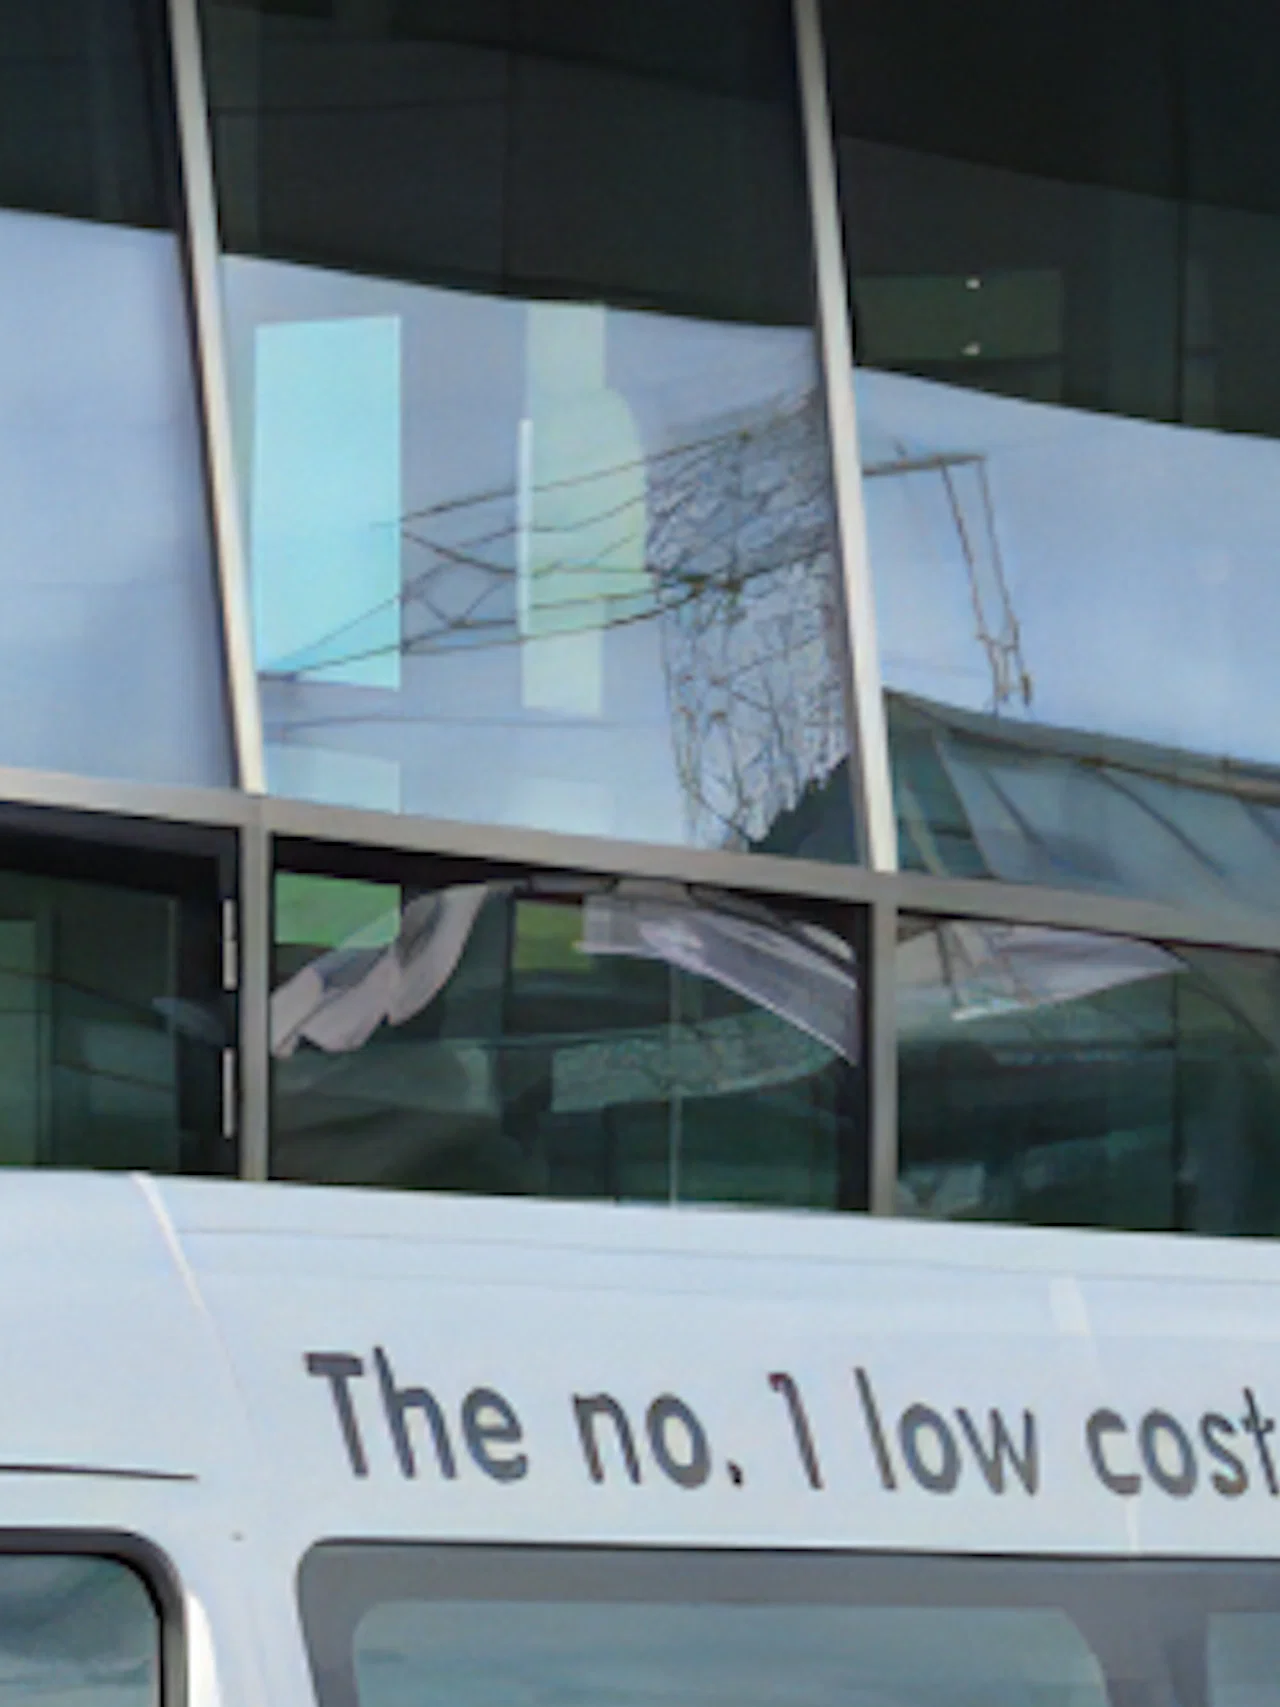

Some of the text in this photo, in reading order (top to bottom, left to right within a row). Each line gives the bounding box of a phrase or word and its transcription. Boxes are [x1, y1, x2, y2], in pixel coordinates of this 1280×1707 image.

[303, 1346, 1280, 1499] The no. 1 low cost
